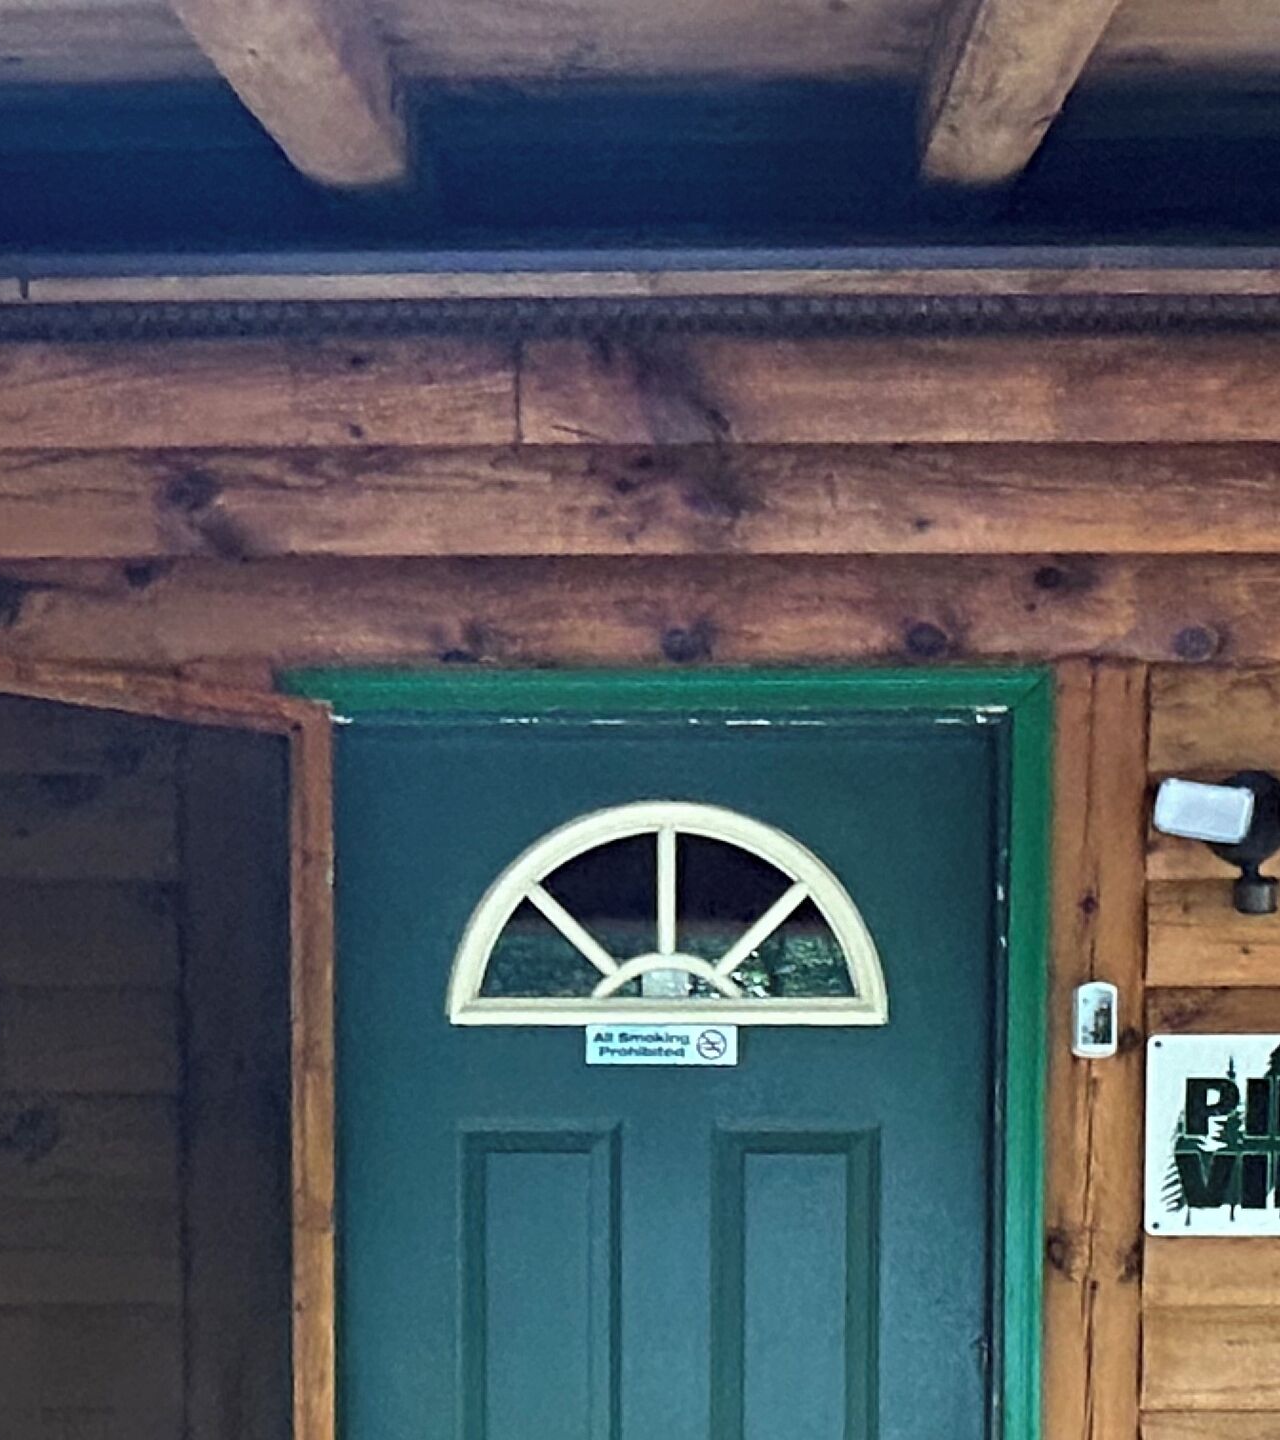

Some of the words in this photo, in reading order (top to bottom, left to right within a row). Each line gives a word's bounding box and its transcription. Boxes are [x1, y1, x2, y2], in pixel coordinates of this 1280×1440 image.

[593, 1032, 613, 1042] All
[618, 1032, 690, 1045] Smoking
[599, 1046, 685, 1057] Prohibited
